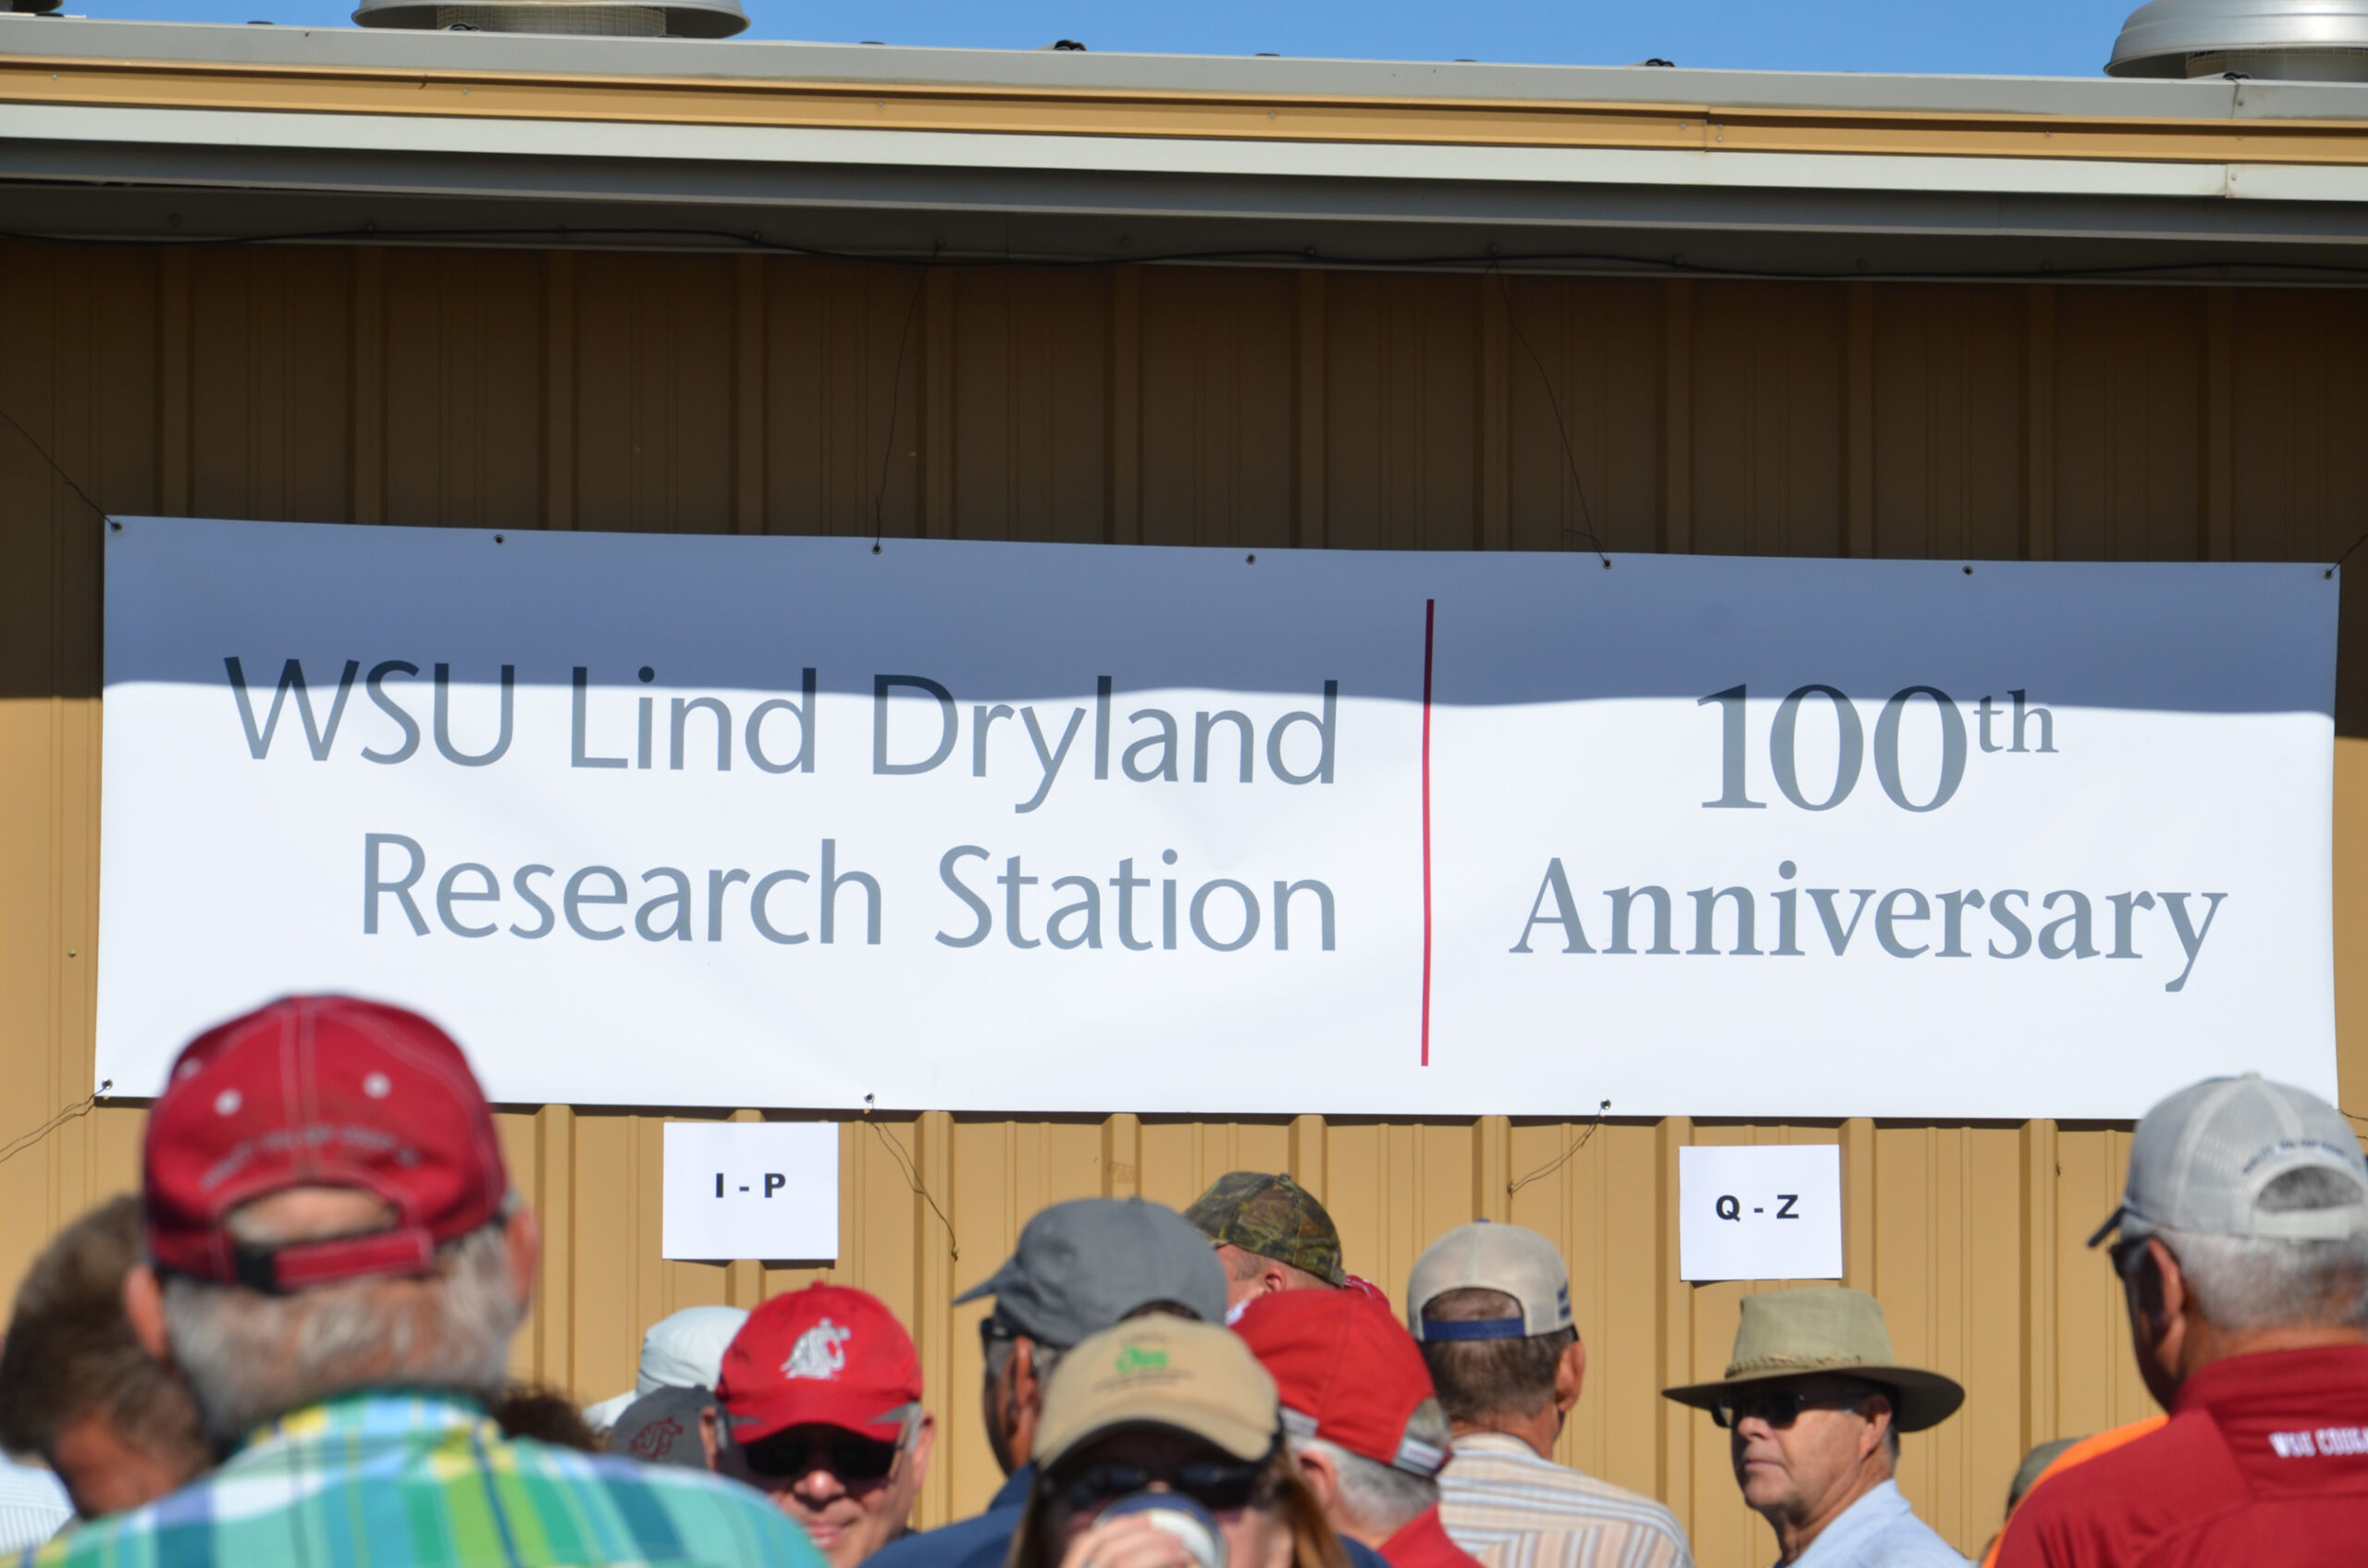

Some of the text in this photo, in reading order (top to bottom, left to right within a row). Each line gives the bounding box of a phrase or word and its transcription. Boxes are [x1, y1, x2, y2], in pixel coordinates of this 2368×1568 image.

[224, 656, 1338, 813] WSU Lind Dryland
[1697, 684, 2060, 812] 100th
[364, 833, 1337, 952] Research Station
[1509, 857, 2229, 993] Anniversary
[715, 1172, 725, 1199] I
[764, 1172, 786, 1199] P
[1715, 1193, 1742, 1223] Q
[1775, 1193, 1800, 1220] Z
